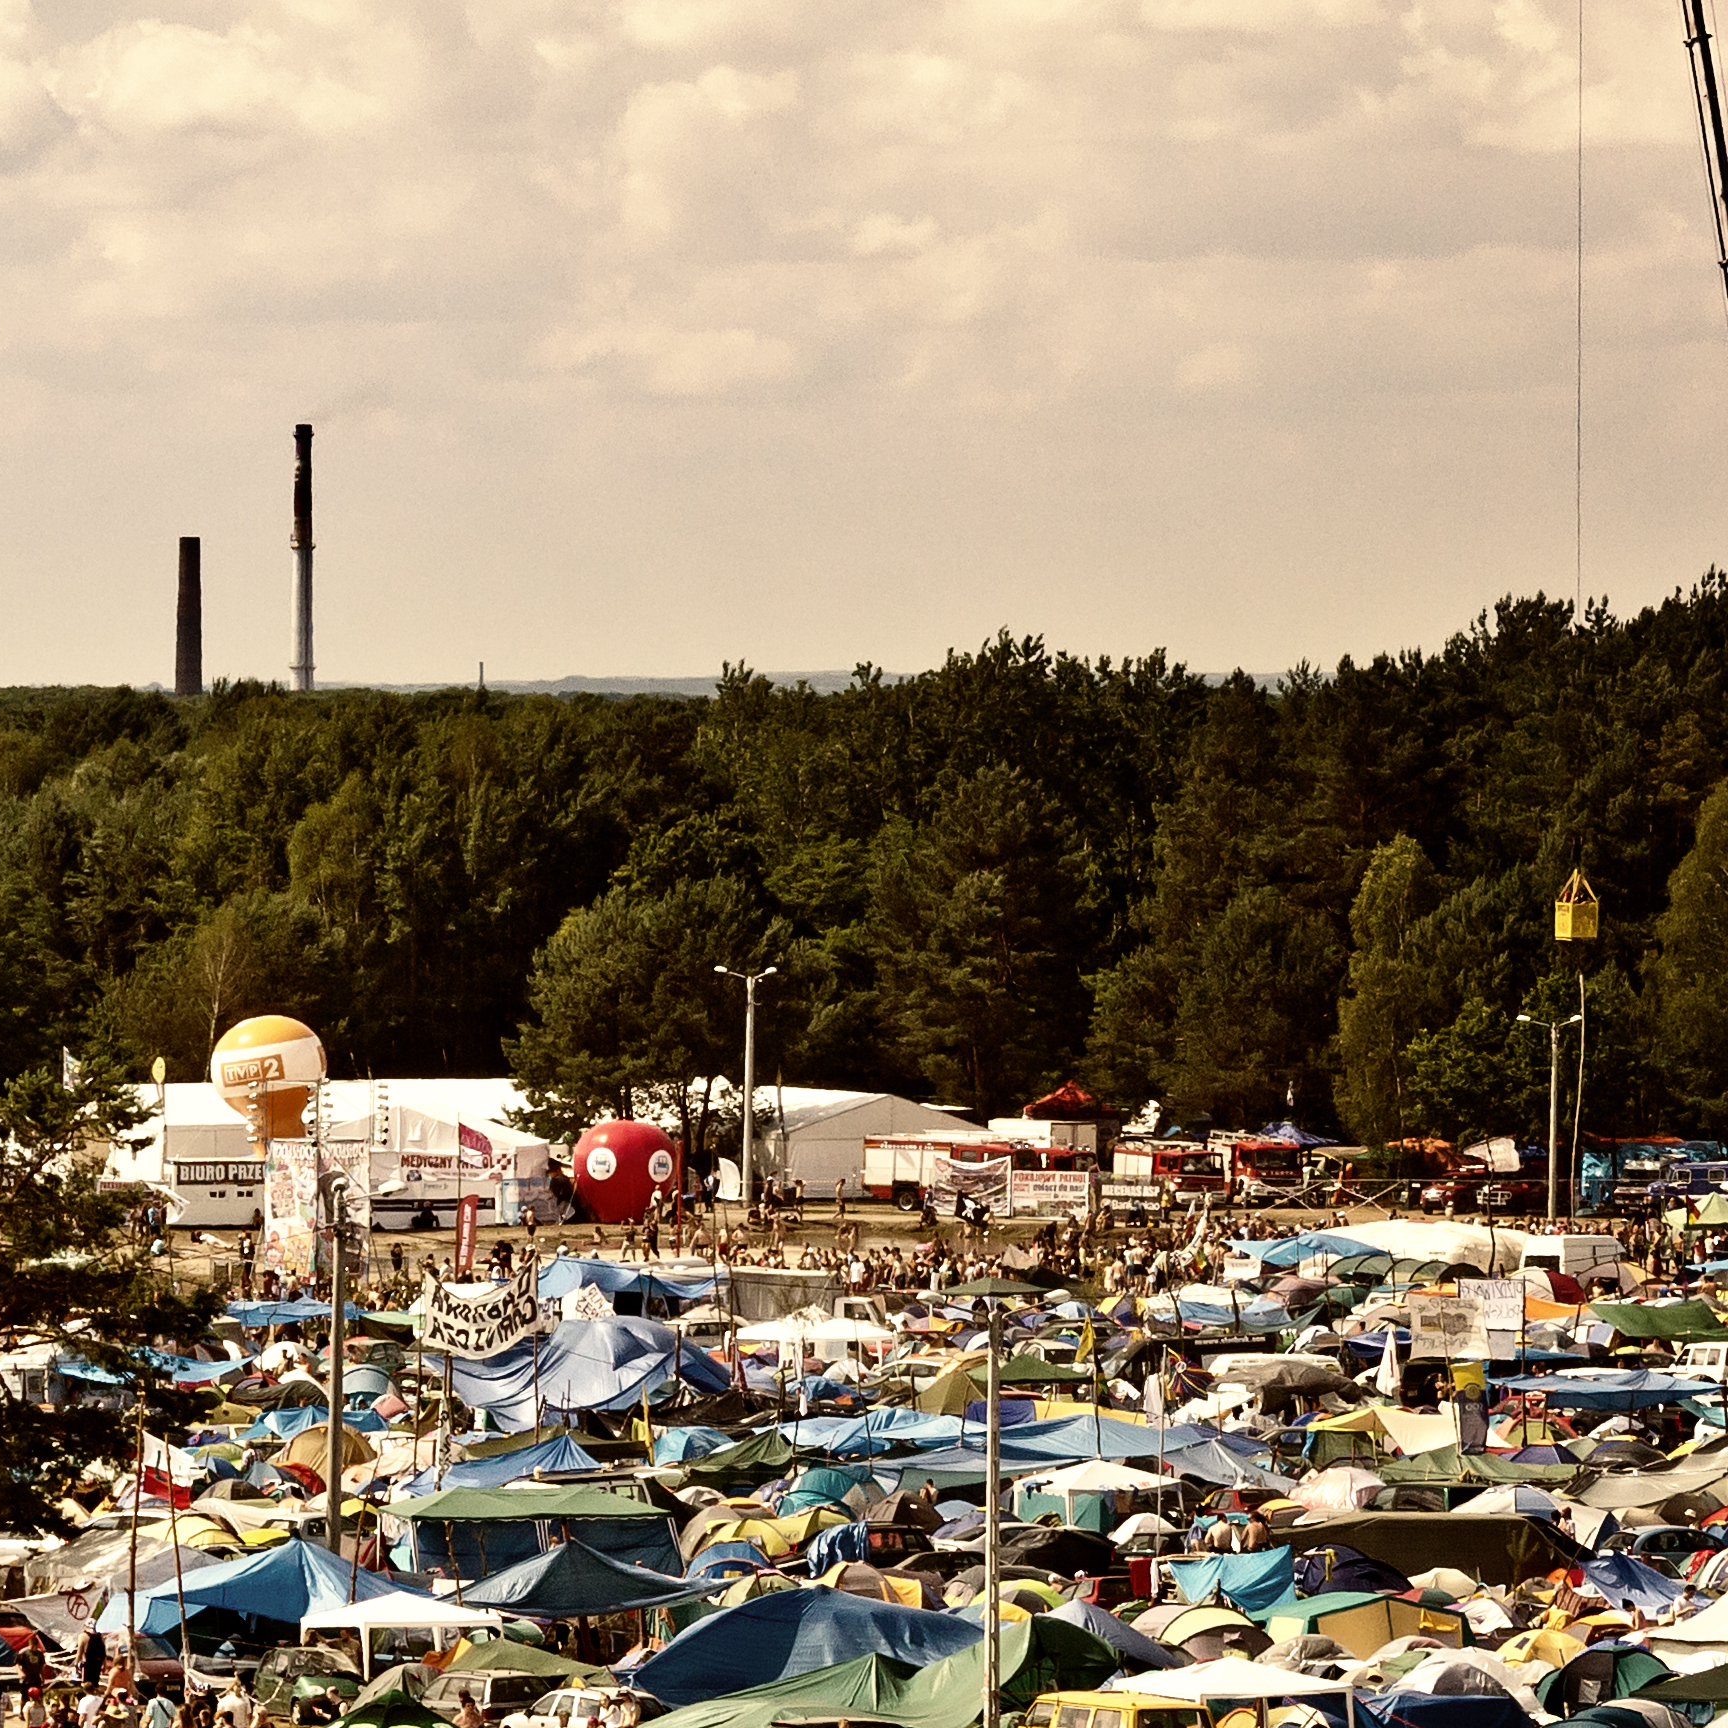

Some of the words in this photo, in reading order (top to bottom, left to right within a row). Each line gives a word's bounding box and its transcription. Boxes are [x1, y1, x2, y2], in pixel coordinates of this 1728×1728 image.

[226, 1063, 260, 1081] TVP
[263, 1058, 280, 1079] 2
[401, 1154, 452, 1169] MEDYCZNY
[180, 1164, 225, 1181] BIURO
[228, 1163, 265, 1181] PRZE
[1102, 1186, 1141, 1197] MECENAS
